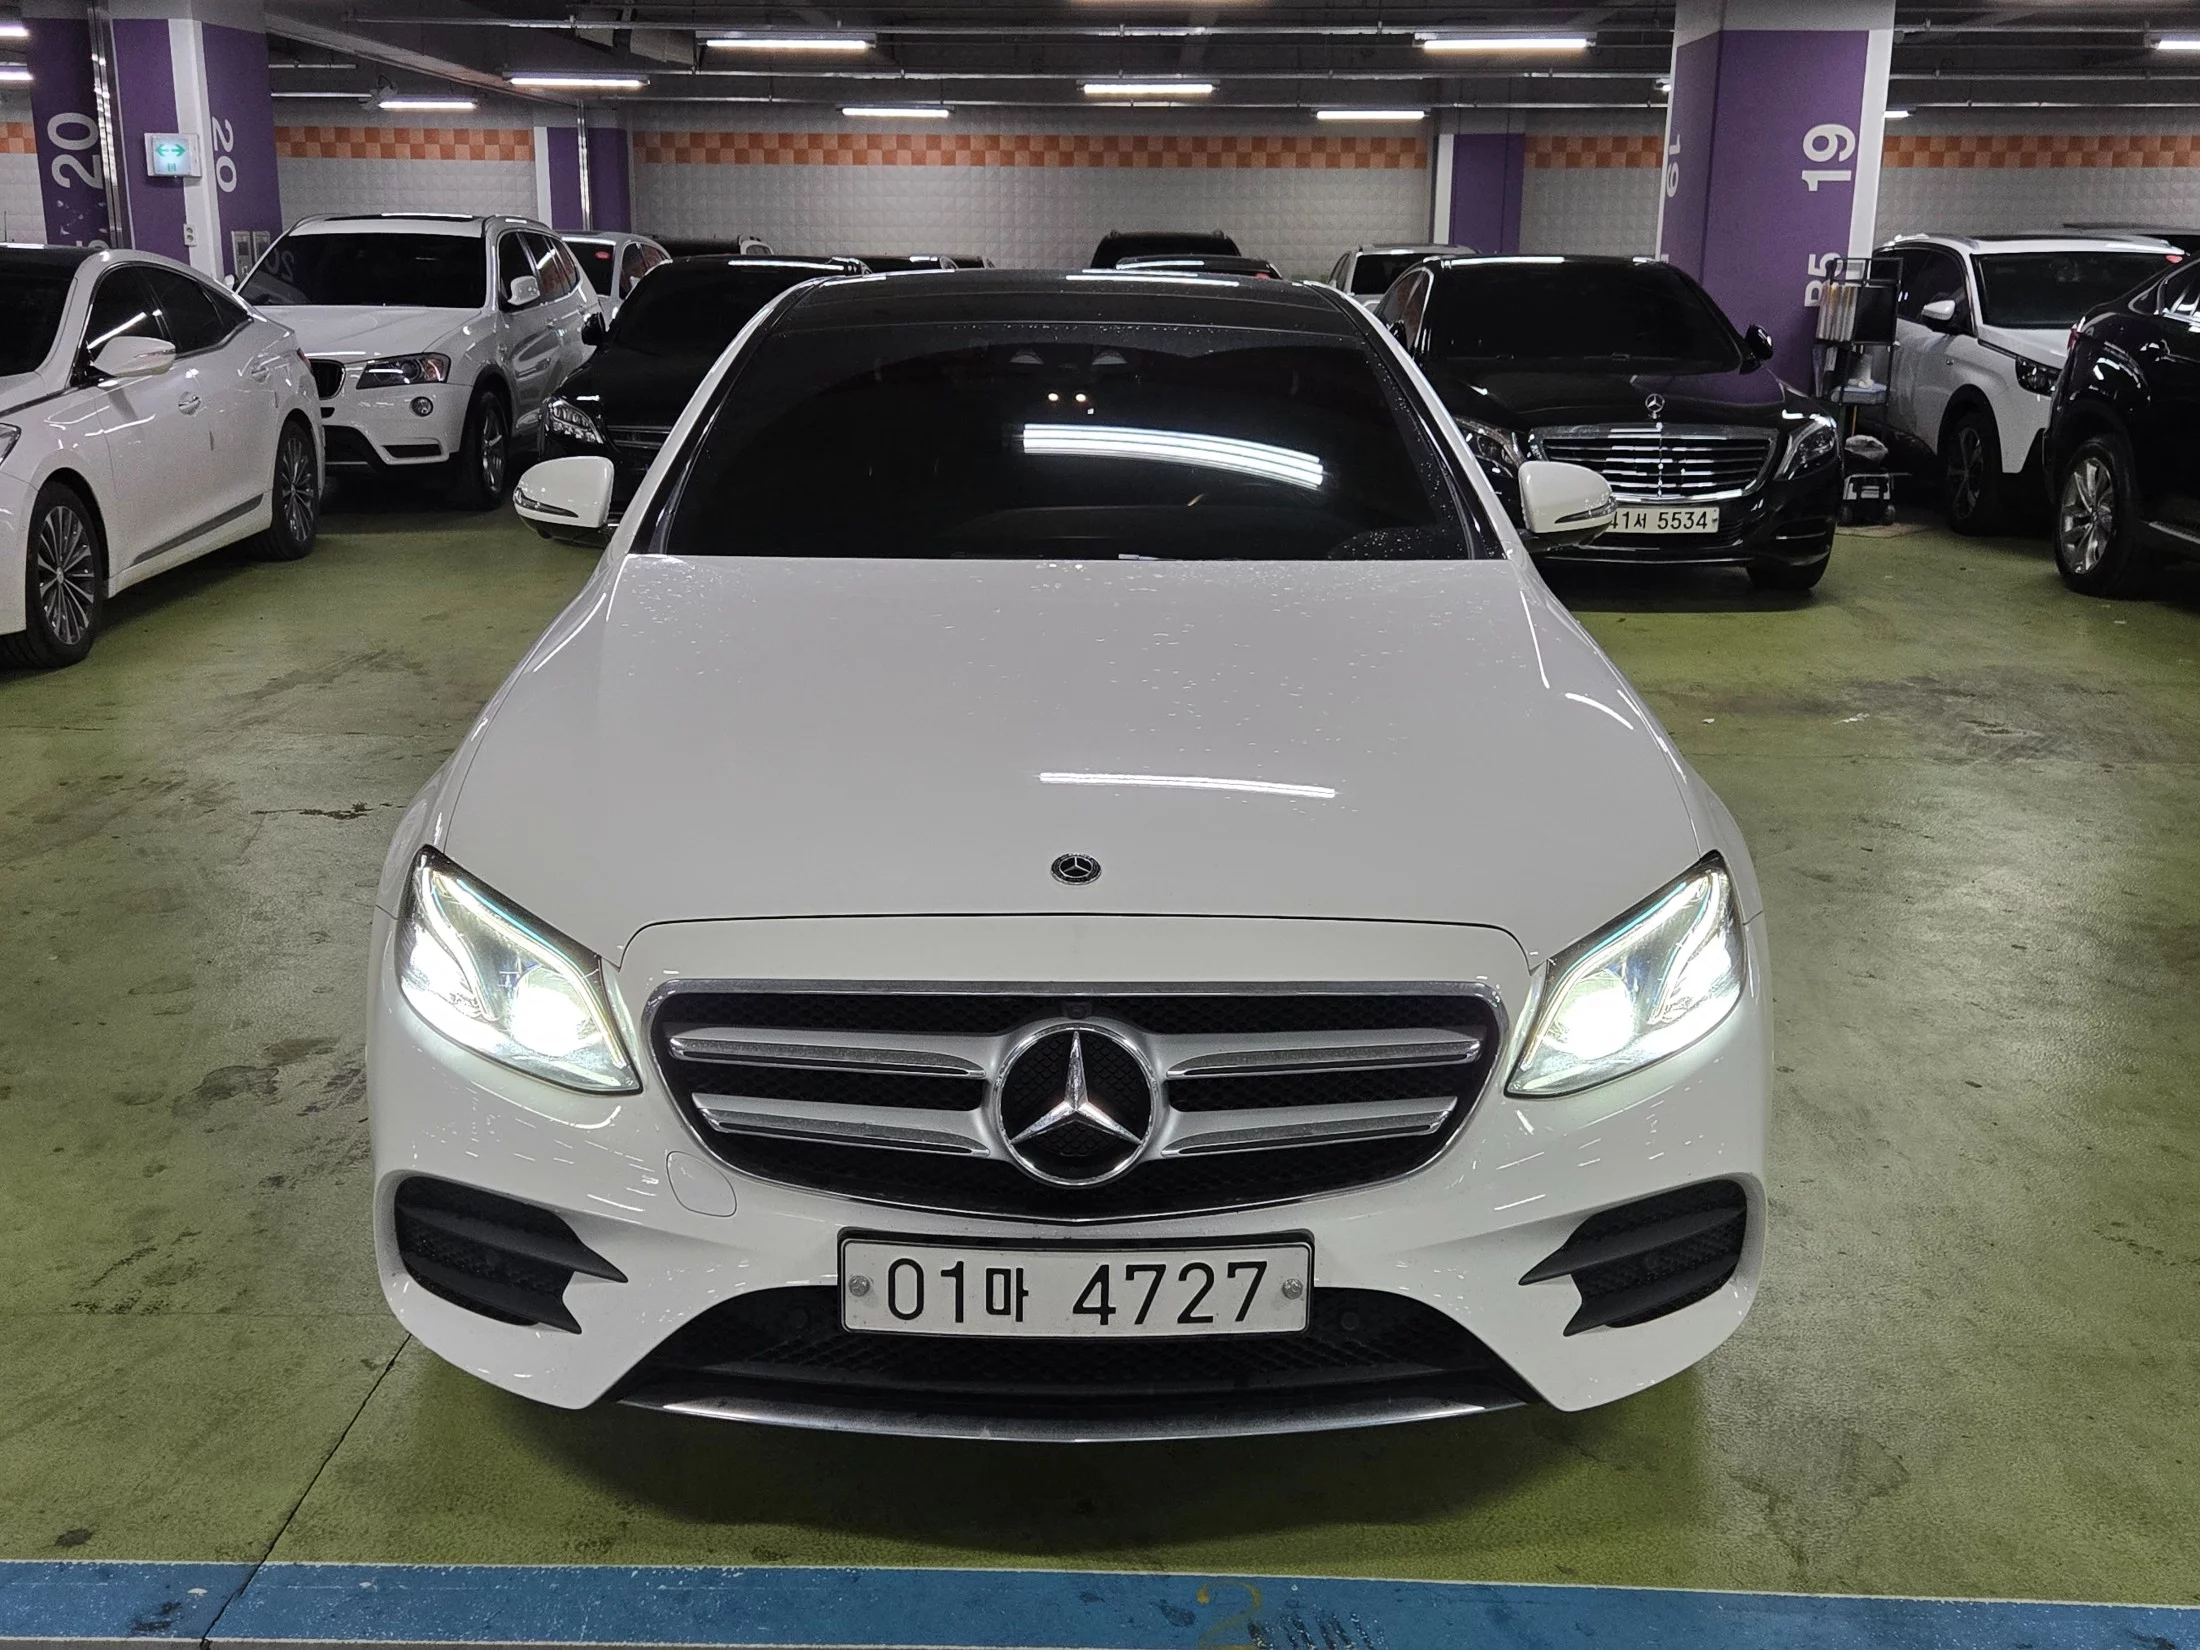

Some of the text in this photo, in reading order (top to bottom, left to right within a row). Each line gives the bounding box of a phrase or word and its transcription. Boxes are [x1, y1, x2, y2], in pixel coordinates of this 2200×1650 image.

[47, 112, 104, 190] 20
[212, 116, 238, 193] 20
[1666, 133, 1682, 198] 19
[1802, 123, 1856, 192] 19
[1657, 511, 1708, 530] 5534
[887, 1257, 1268, 1326] 01마 4727
